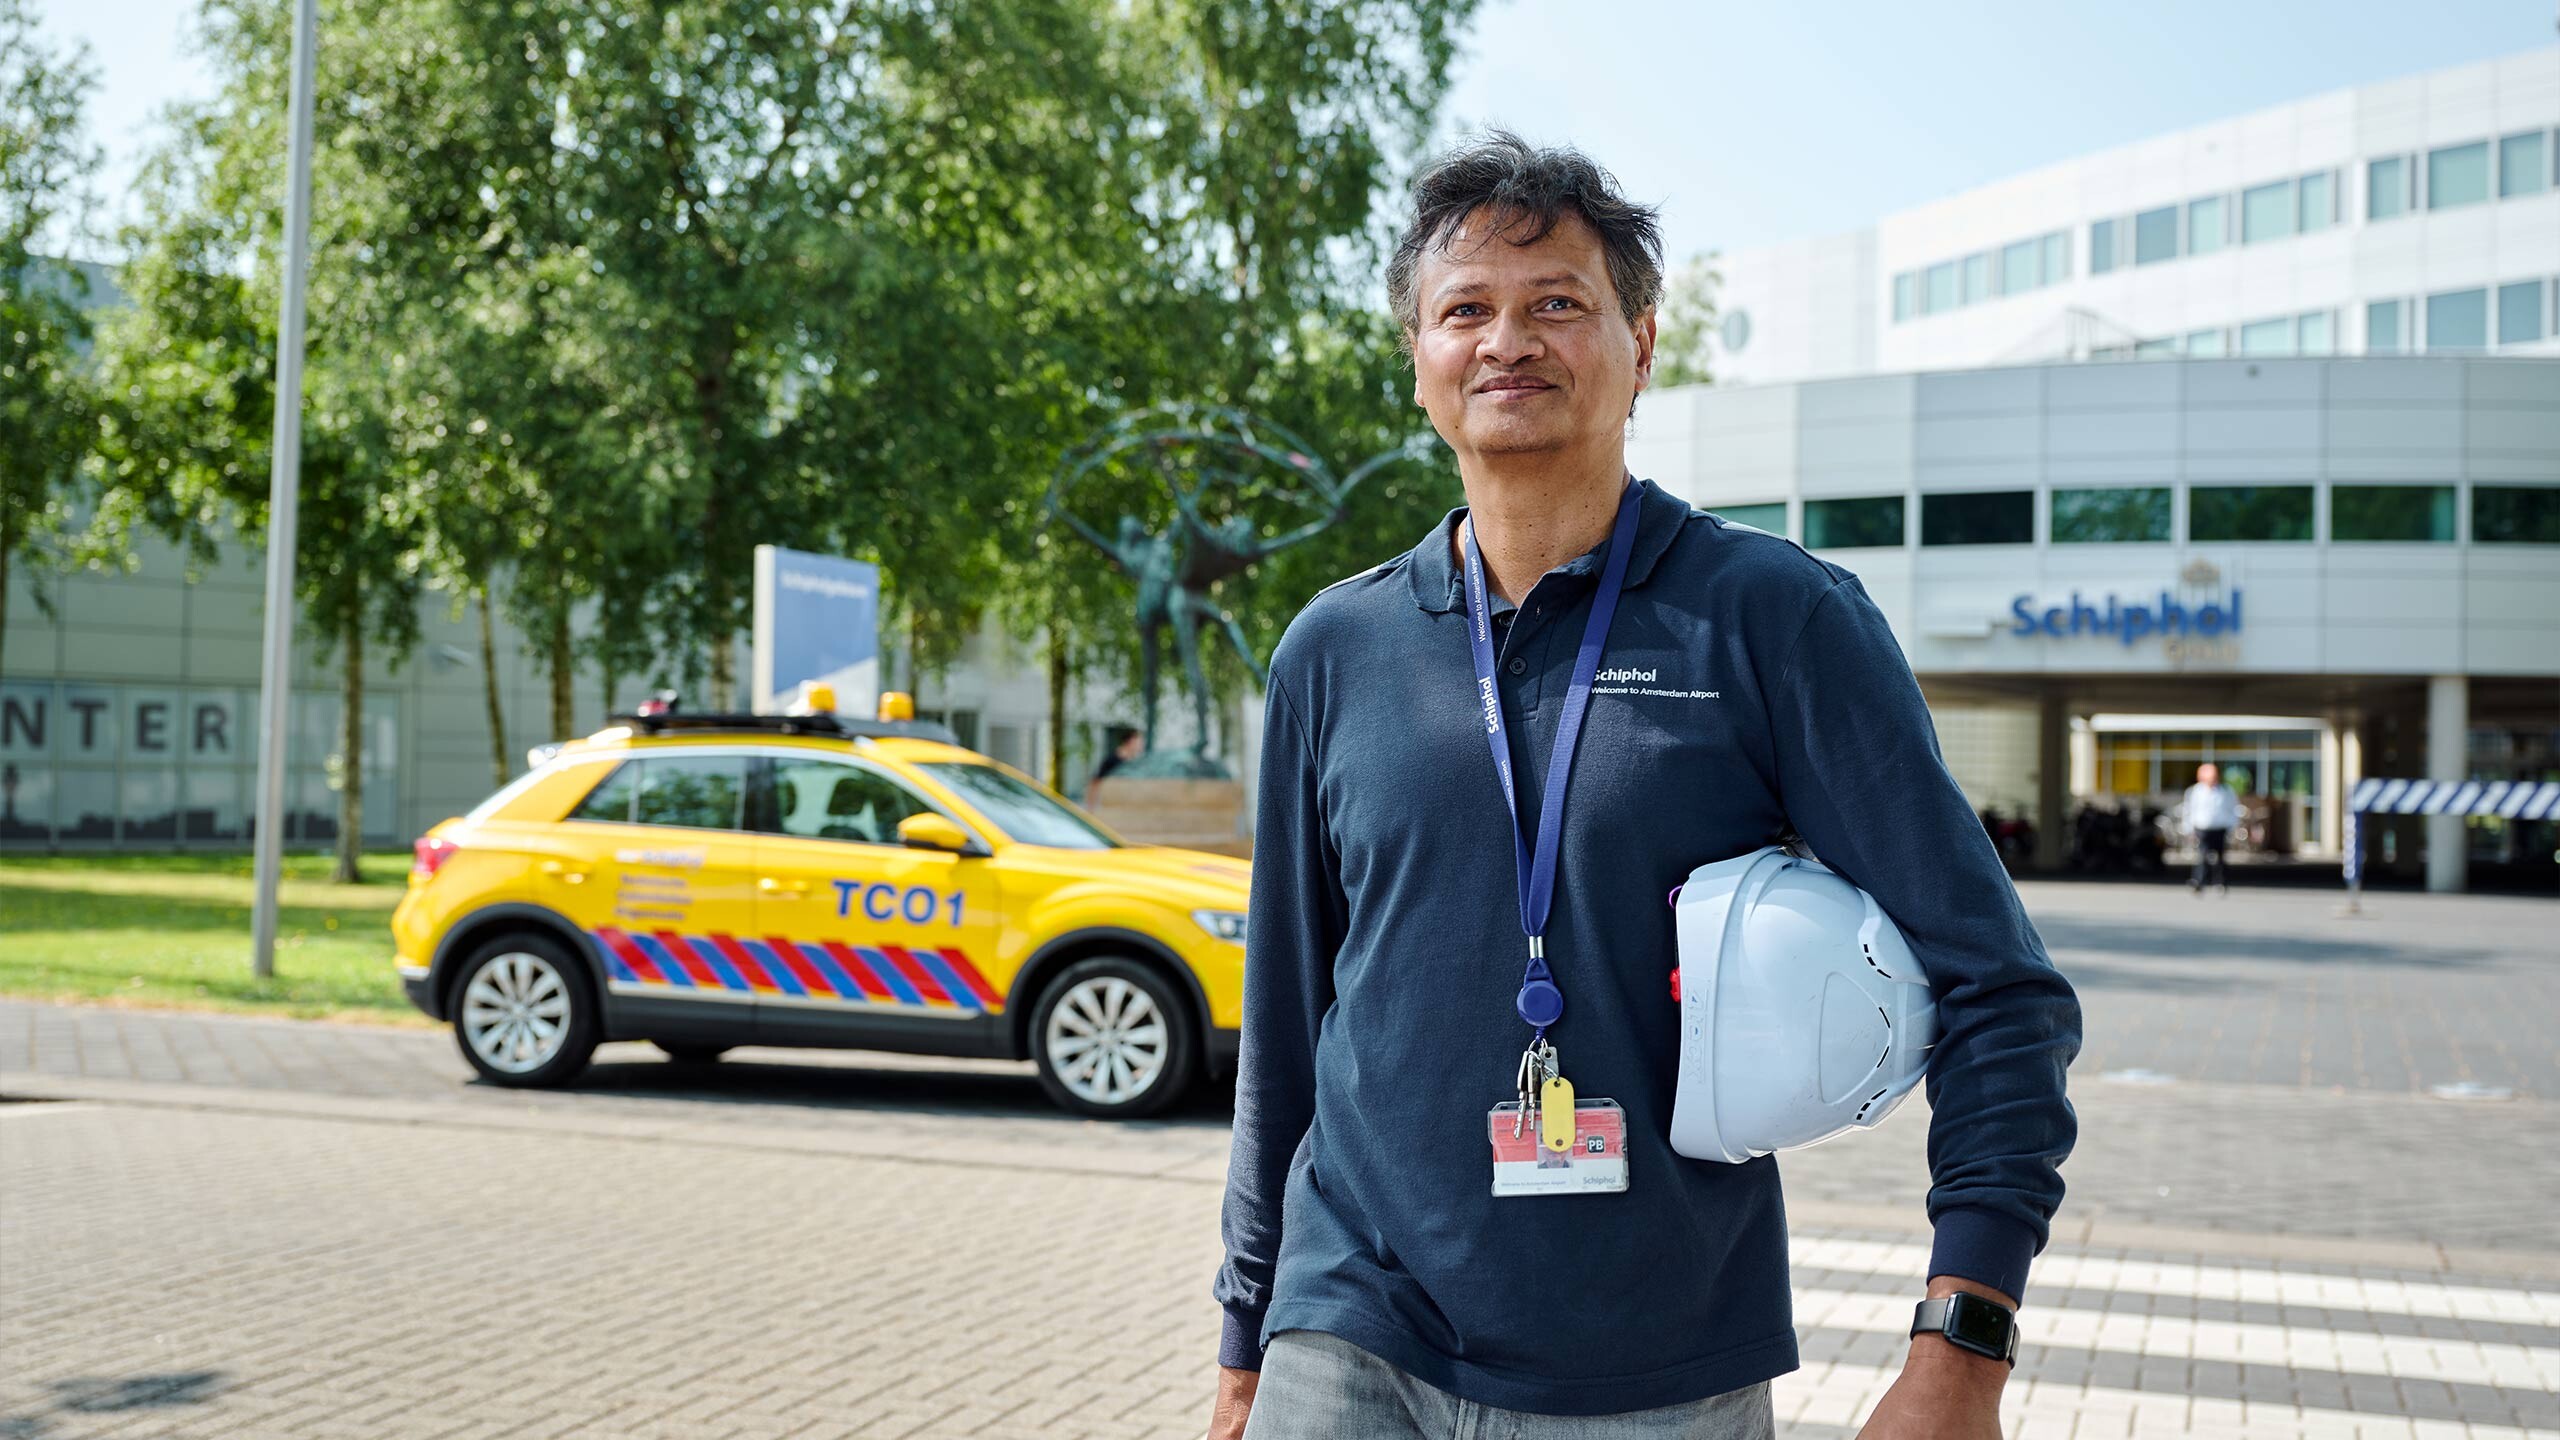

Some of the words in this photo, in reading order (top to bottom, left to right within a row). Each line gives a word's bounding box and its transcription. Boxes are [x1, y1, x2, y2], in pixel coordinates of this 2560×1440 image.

[1476, 603, 1483, 611] to
[2011, 588, 2242, 646] Schiphol
[1477, 611, 1486, 642] Welcome
[1640, 688, 1688, 698] Amsterdam
[1689, 690, 1719, 699] Airport
[1479, 676, 1499, 734] Schiphol
[1, 698, 228, 751] NTER
[1588, 1140, 1604, 1151] PB
[1583, 1176, 1616, 1185] Schiphol
